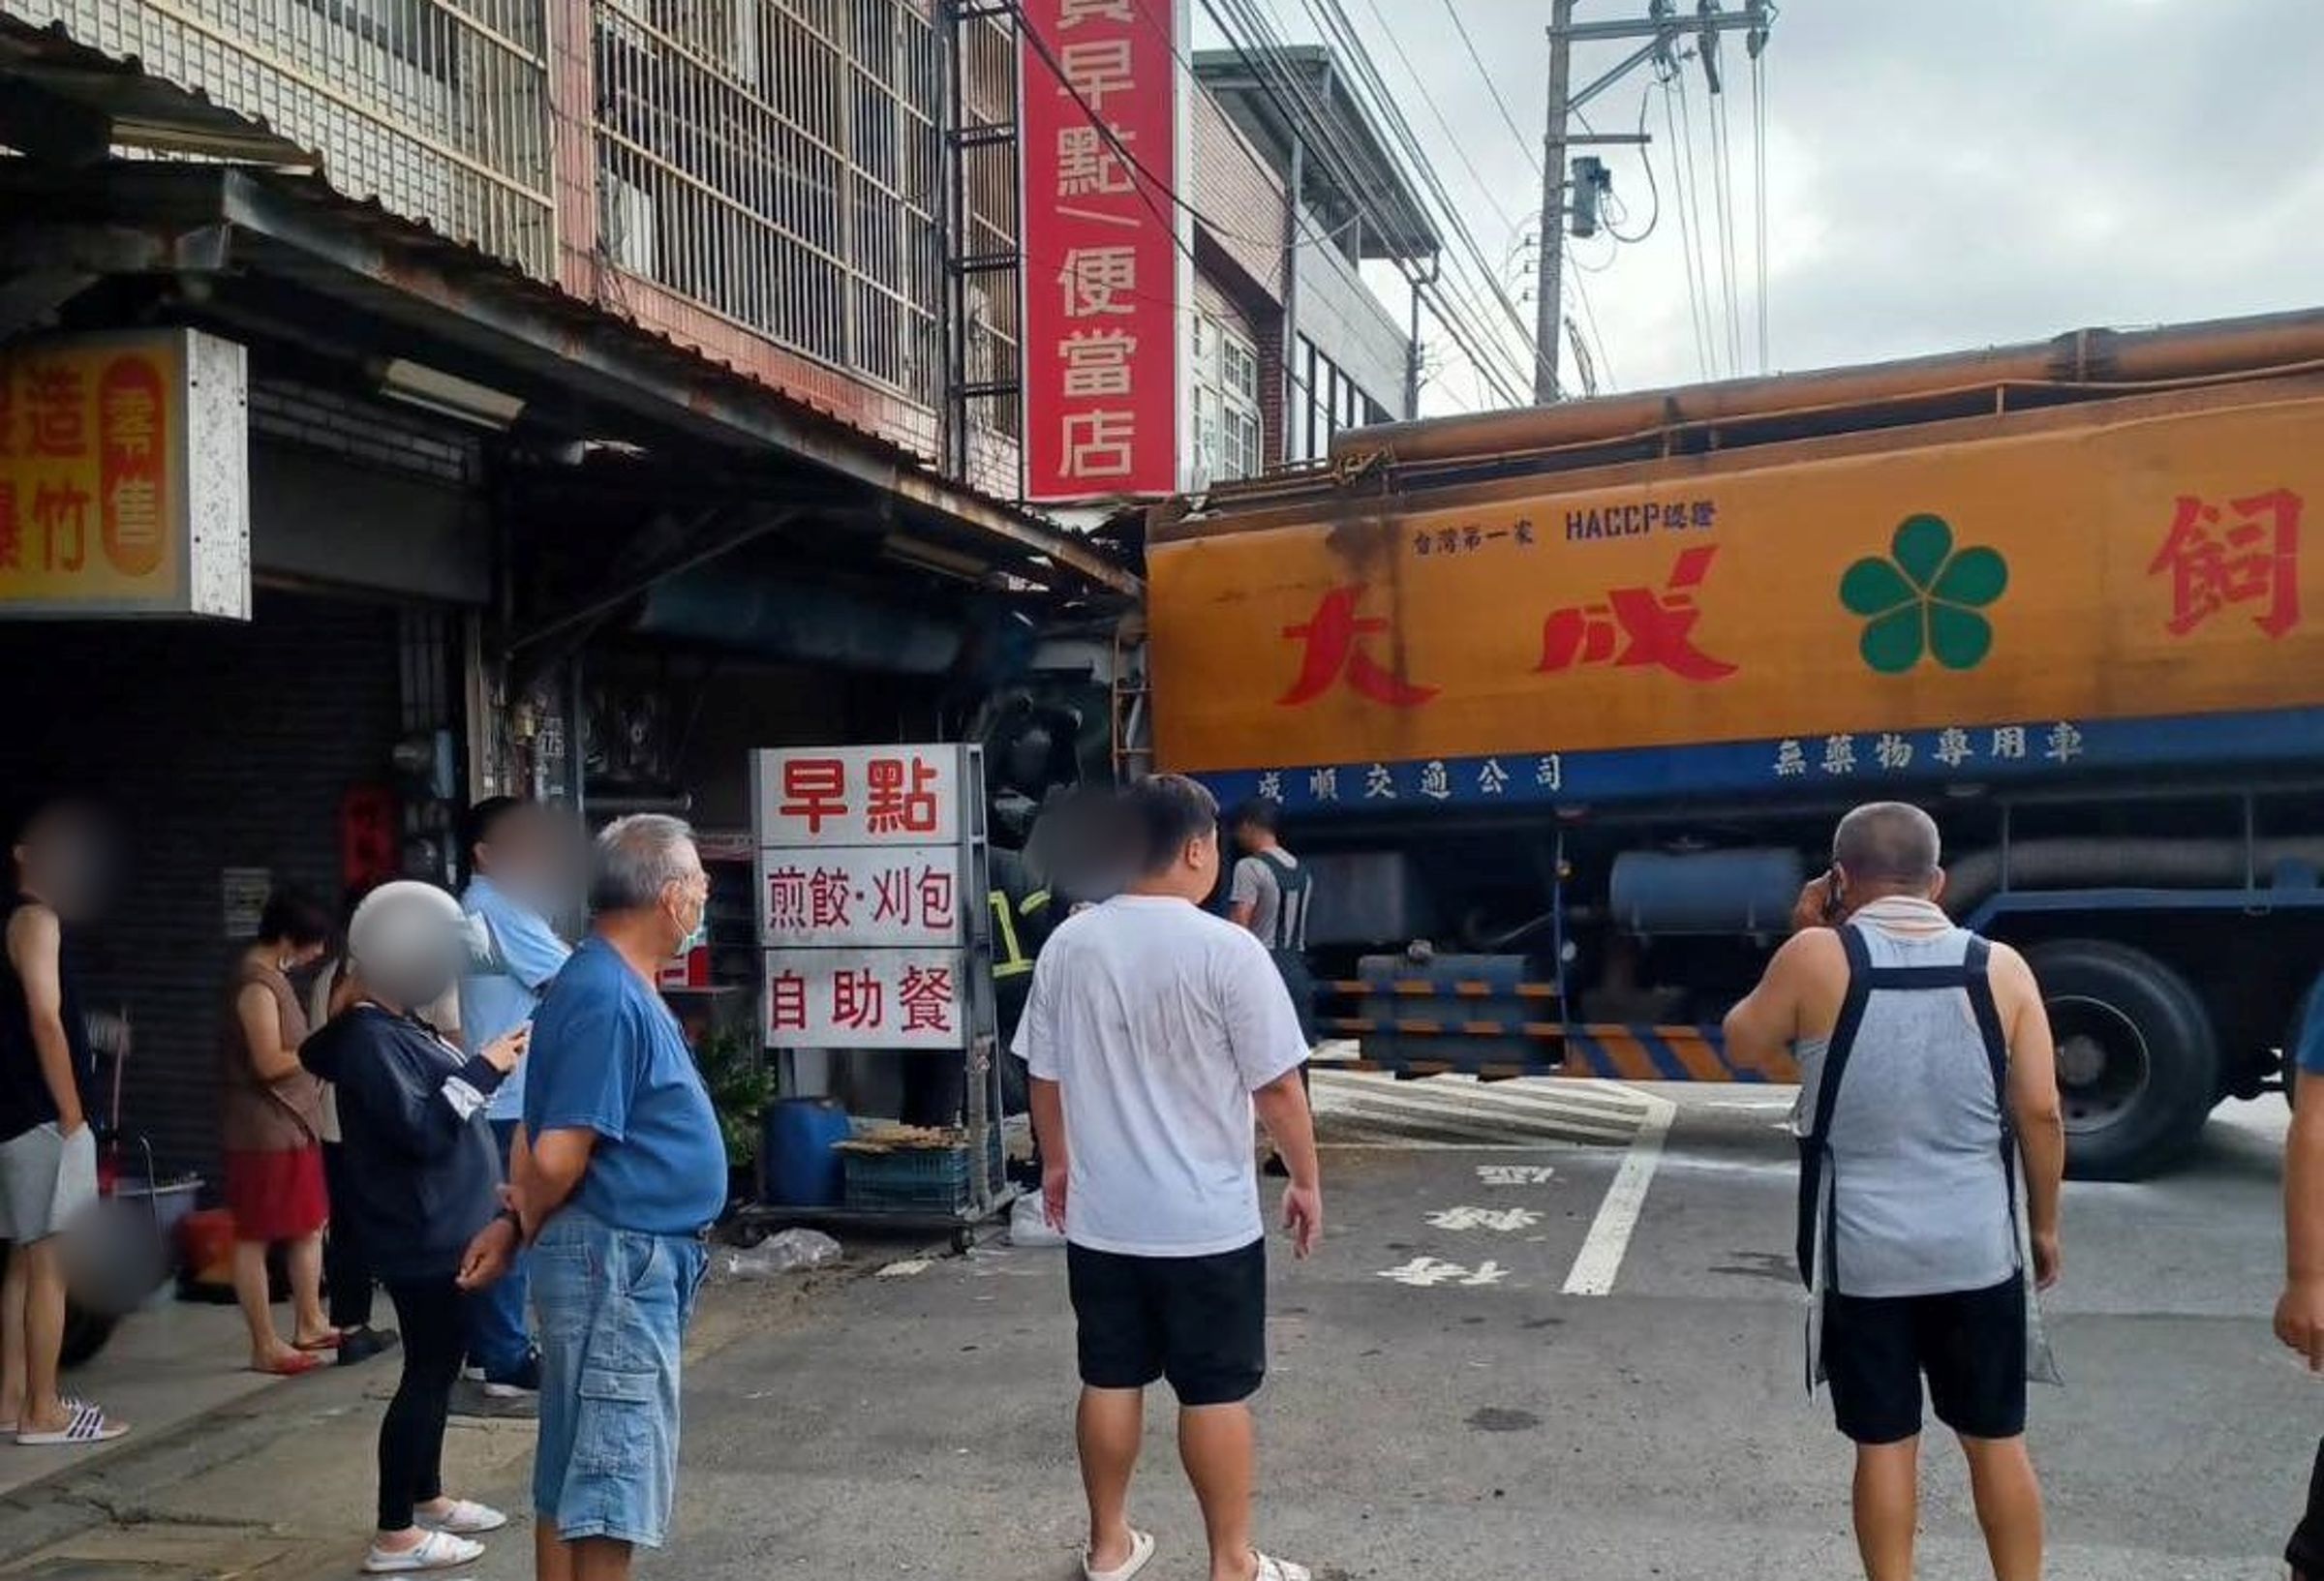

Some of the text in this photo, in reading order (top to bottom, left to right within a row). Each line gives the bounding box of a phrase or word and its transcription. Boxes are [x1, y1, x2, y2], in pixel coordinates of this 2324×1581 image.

[0, 366, 87, 458] 造
[1412, 519, 1534, 556] 台灣第一家
[1565, 501, 1716, 541] HACCP認證
[2147, 487, 2305, 641] 飼
[1773, 721, 2083, 775] 無藥物專用車
[780, 756, 939, 834] 早點
[771, 965, 954, 1034] 自助餐
